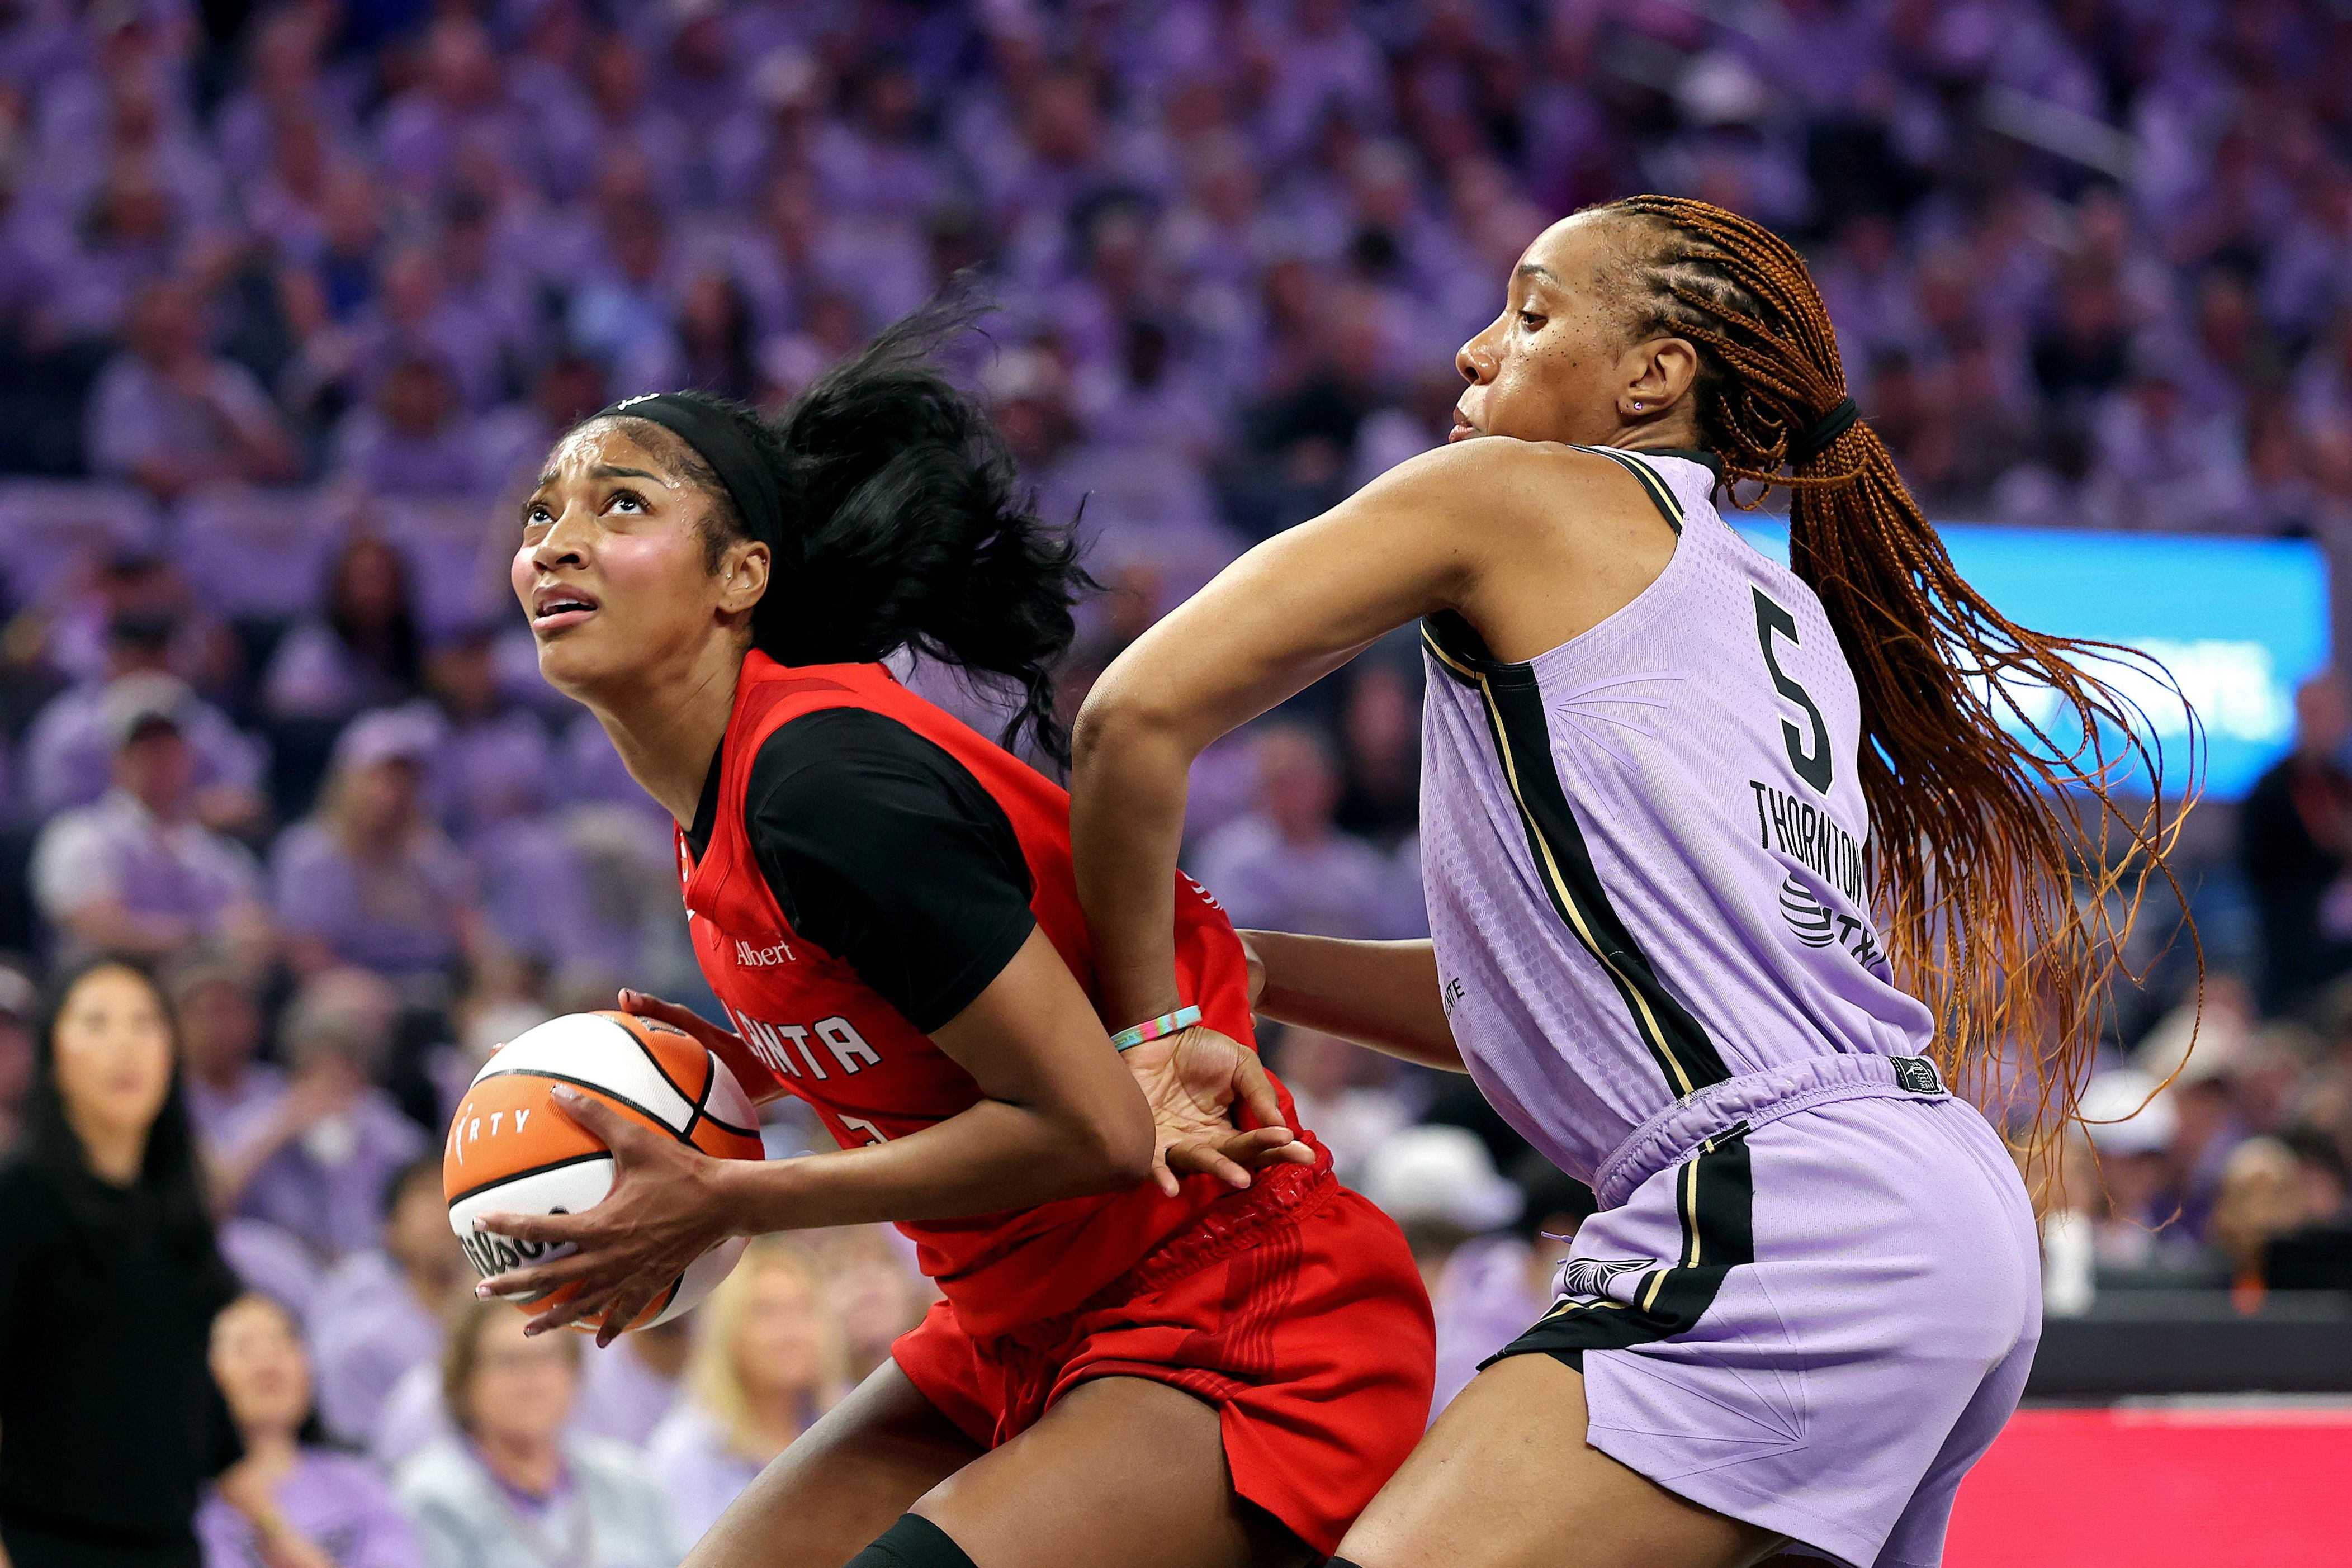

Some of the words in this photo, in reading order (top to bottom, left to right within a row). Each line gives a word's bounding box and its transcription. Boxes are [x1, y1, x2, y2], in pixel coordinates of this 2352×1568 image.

[1748, 579, 1835, 800] 5
[1750, 780, 1863, 908] THORNTON
[735, 939, 797, 967] Albert
